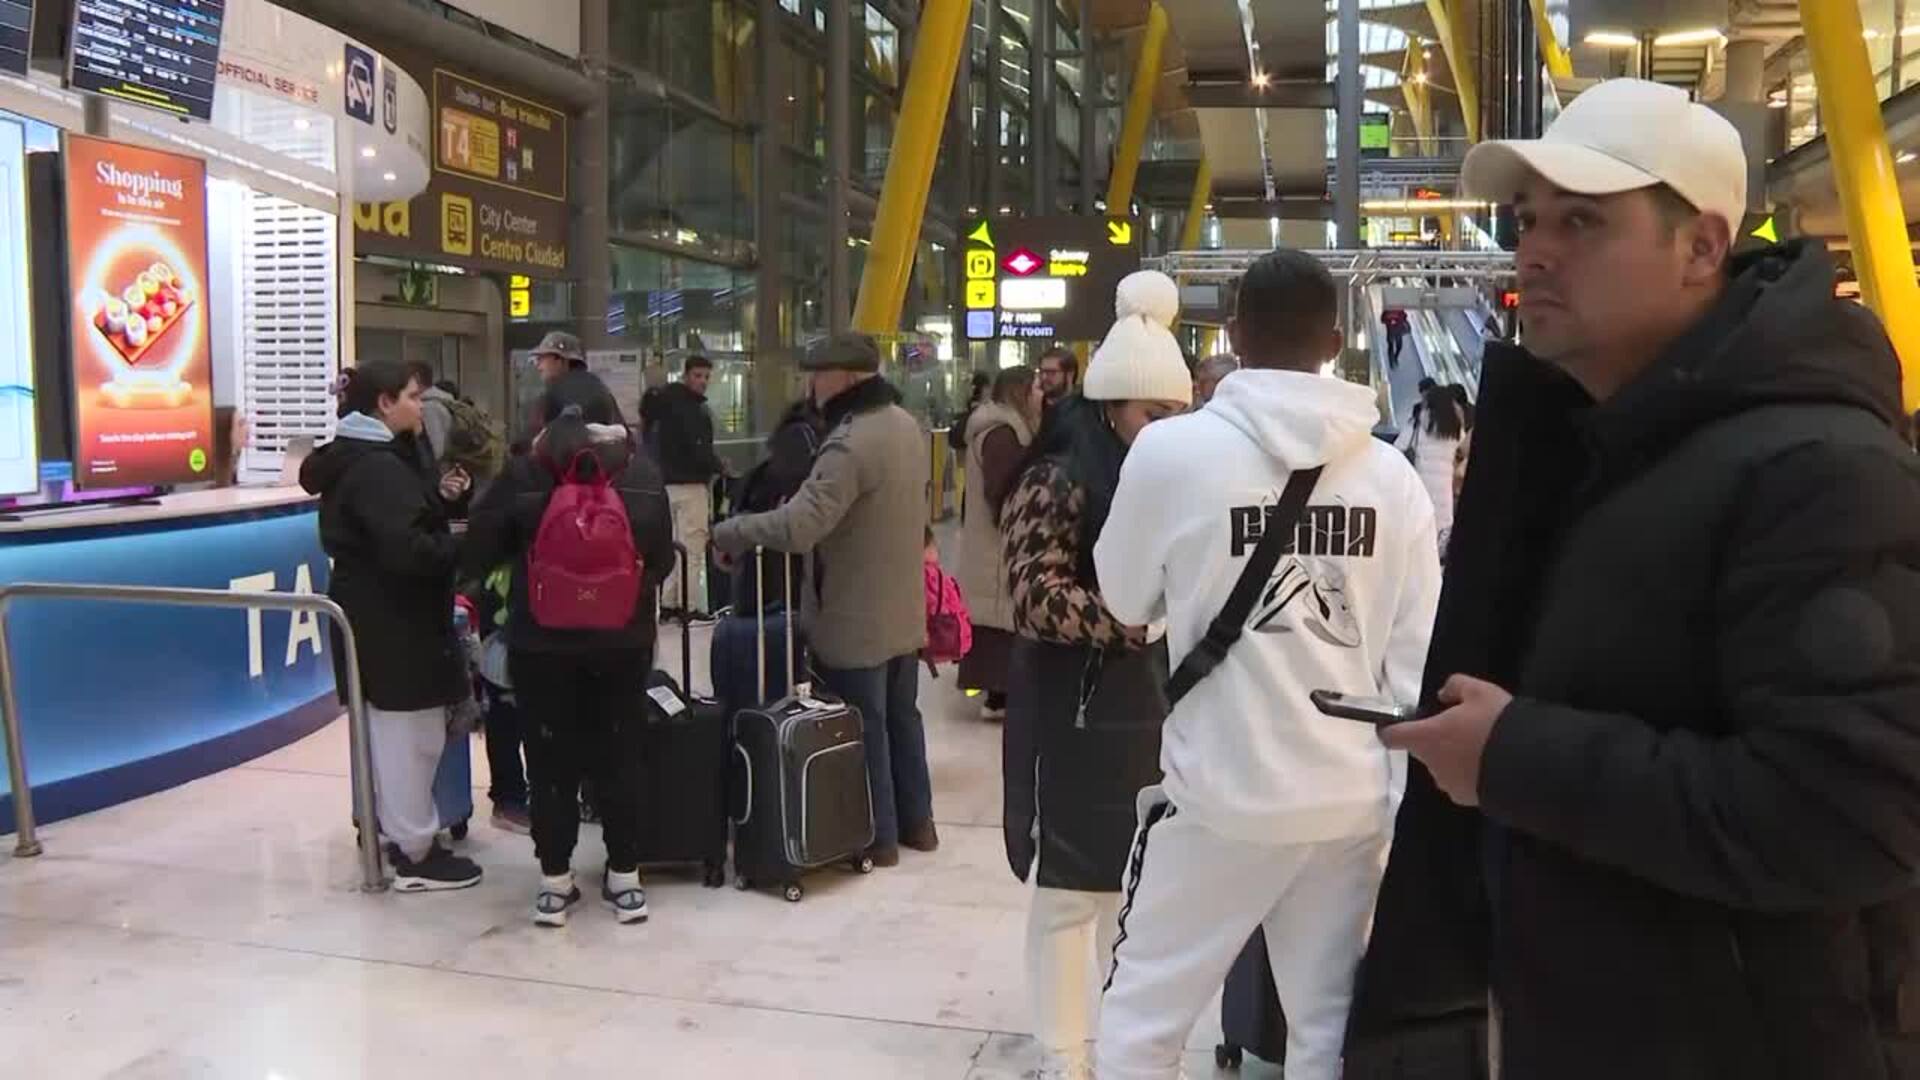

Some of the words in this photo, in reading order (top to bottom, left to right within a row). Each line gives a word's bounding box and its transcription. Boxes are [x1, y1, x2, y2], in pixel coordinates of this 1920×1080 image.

[216, 61, 271, 88] OFFICIAL
[443, 121, 470, 166] T4
[96, 160, 183, 200] Shopping
[479, 203, 501, 228] City
[503, 209, 539, 234] Center
[480, 233, 524, 261] Centro
[525, 242, 565, 269] Ciudad
[1001, 324, 1018, 337] Air
[1020, 326, 1053, 337] room
[229, 556, 336, 678] TA
